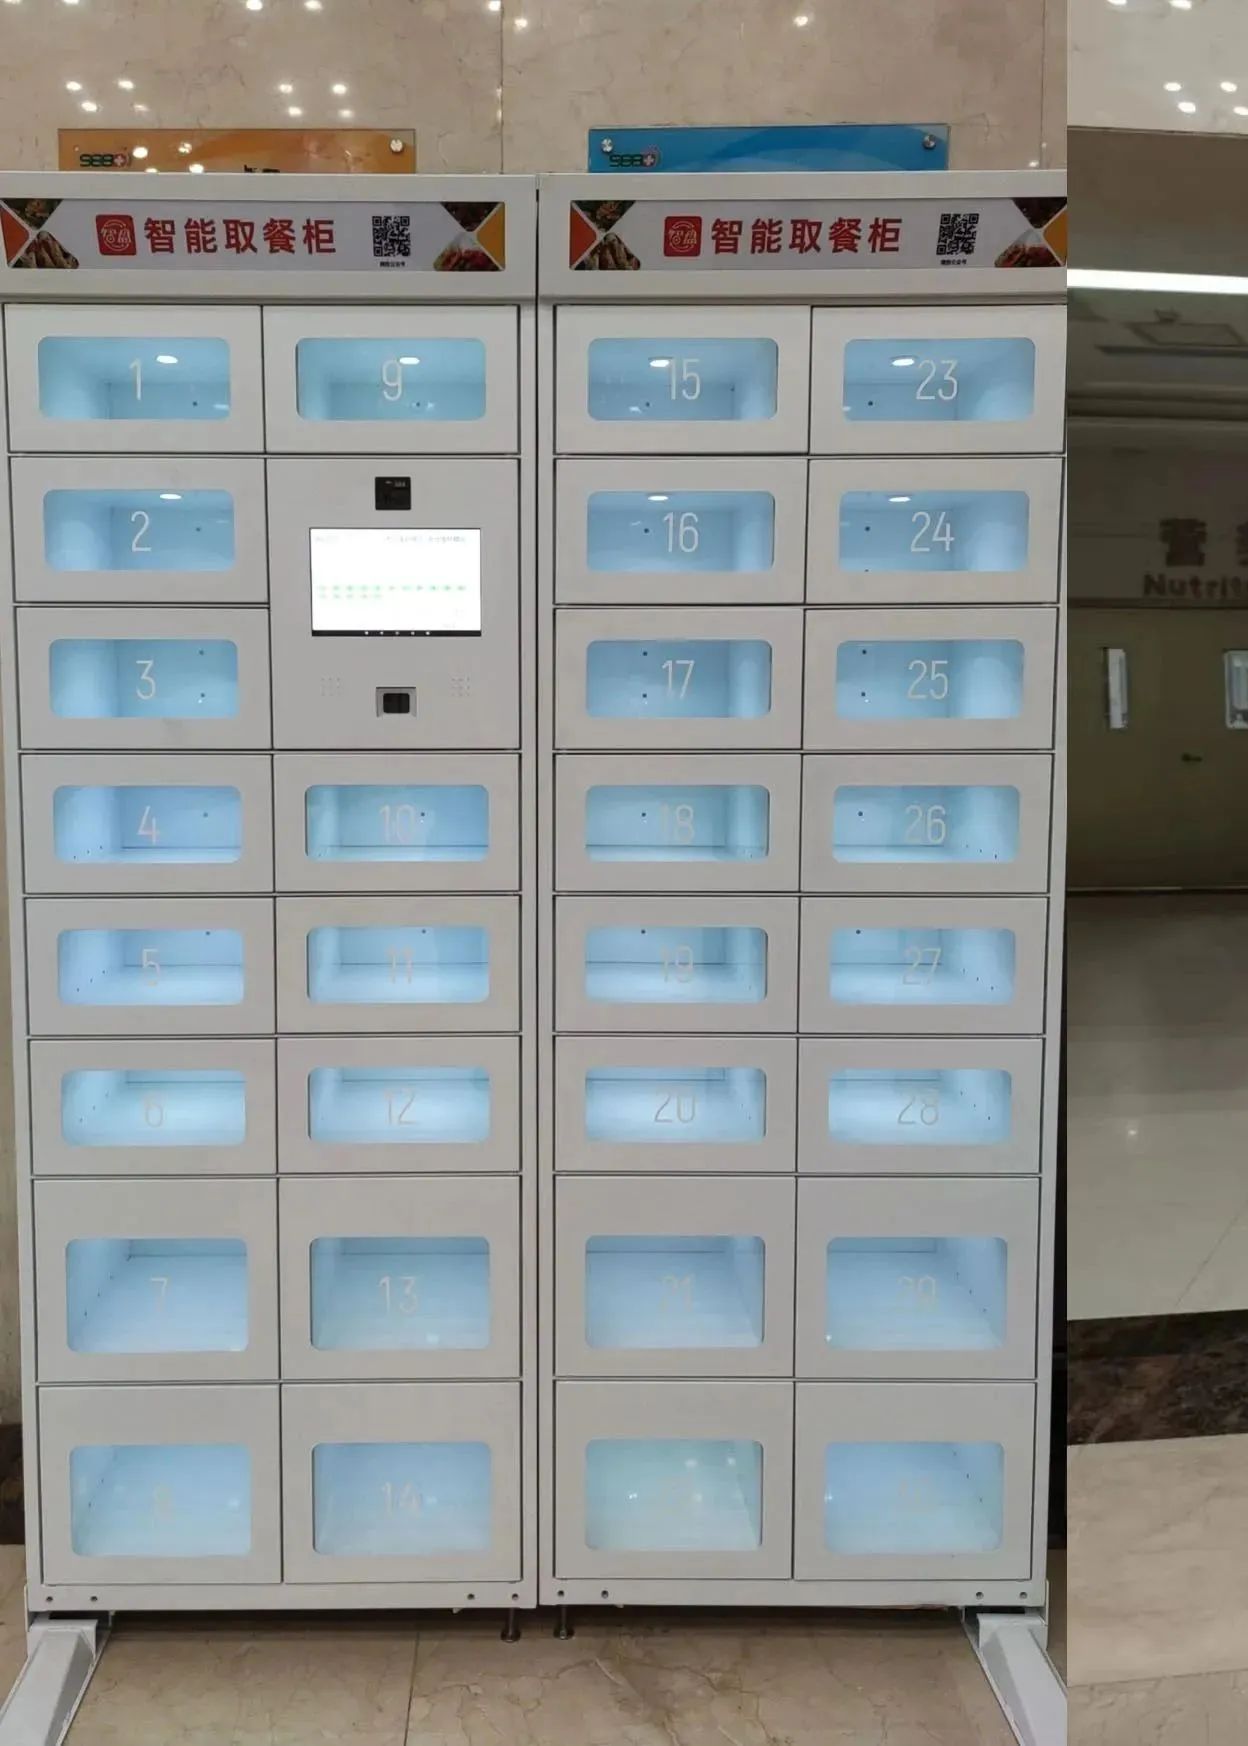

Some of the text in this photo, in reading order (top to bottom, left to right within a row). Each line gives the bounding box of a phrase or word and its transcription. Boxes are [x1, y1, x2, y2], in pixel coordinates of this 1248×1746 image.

[144, 216, 336, 255] 智能取餐柜
[711, 216, 904, 255] 智能取餐柜
[129, 357, 142, 401] 1
[381, 359, 402, 402] 9
[667, 357, 702, 401] 15
[914, 359, 959, 402] 23
[130, 511, 152, 552] 2
[662, 511, 700, 553] 16
[909, 511, 955, 553] 24
[135, 660, 157, 700] 3
[661, 659, 696, 699] 17
[907, 659, 950, 700] 25
[136, 805, 161, 845] 4
[379, 804, 416, 844] 10
[659, 804, 695, 844] 18
[904, 804, 947, 845] 26
[141, 947, 162, 987] 5
[662, 945, 695, 984] 19
[903, 946, 943, 986] 27
[653, 1087, 696, 1124] 20
[897, 1088, 940, 1126] 28
[149, 1276, 169, 1314] 7
[378, 1275, 420, 1315] 13
